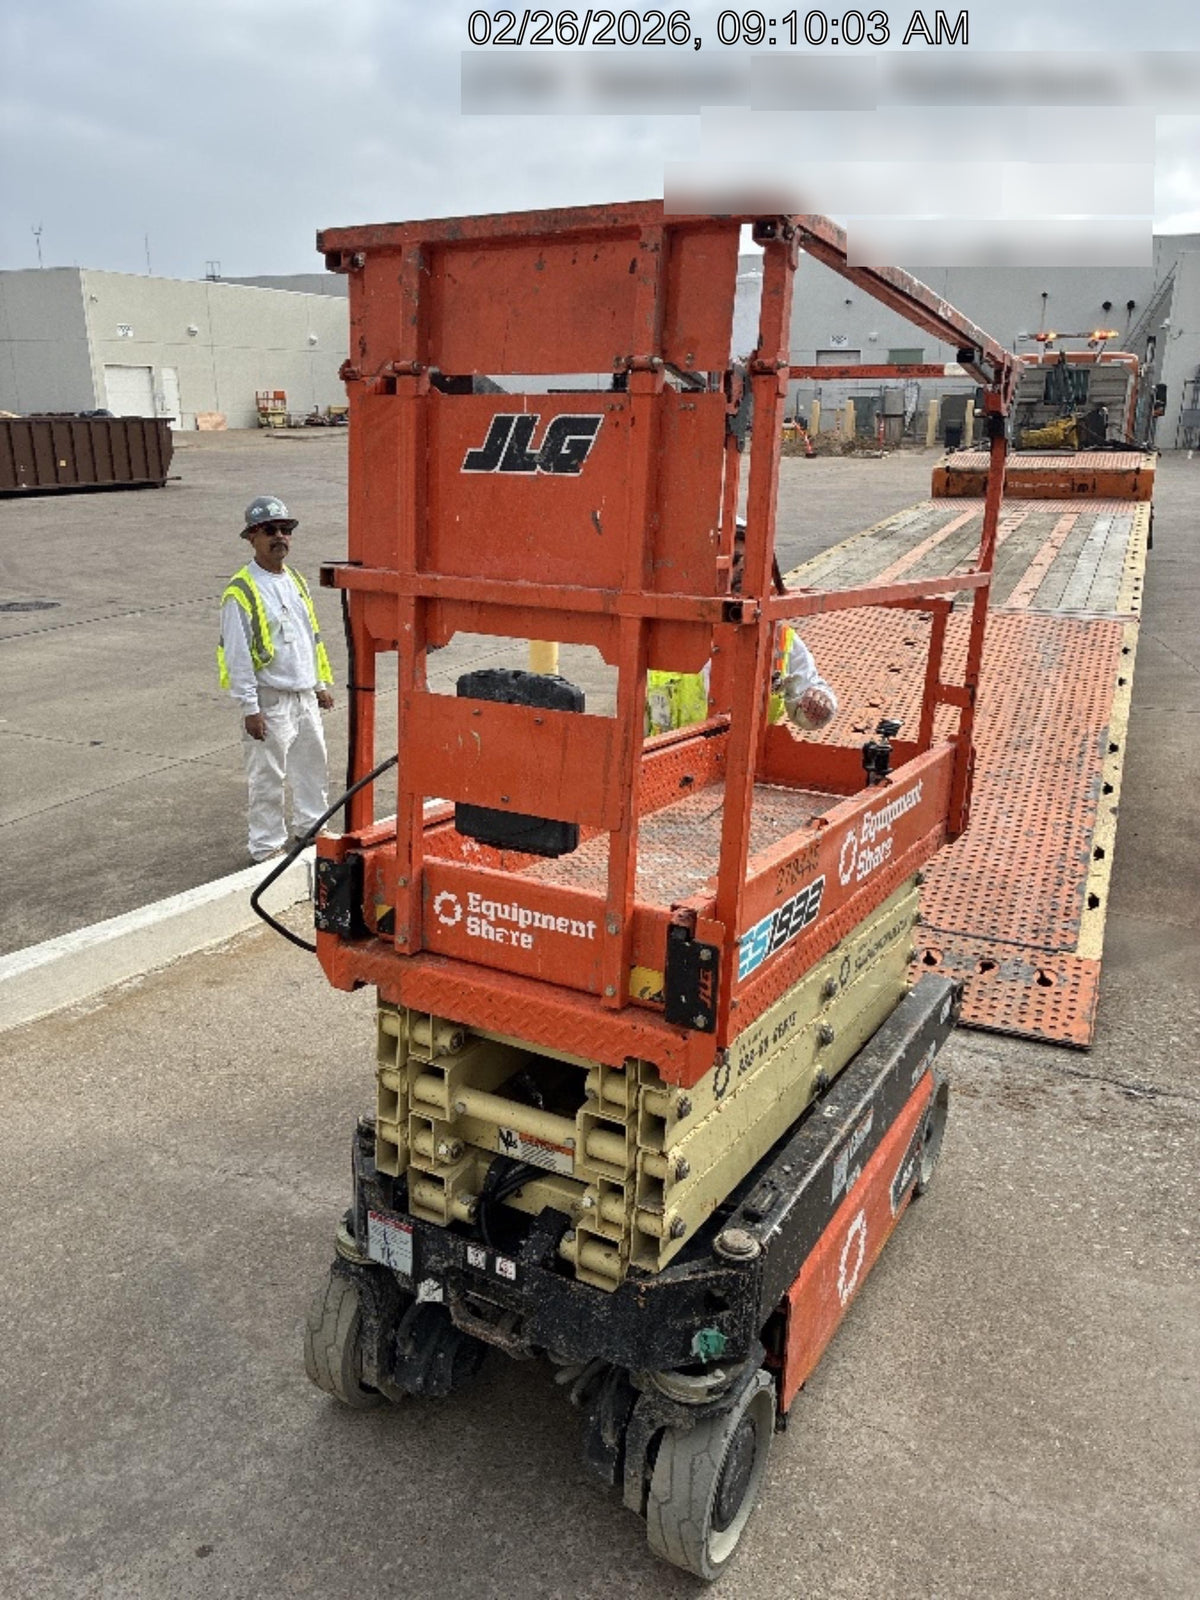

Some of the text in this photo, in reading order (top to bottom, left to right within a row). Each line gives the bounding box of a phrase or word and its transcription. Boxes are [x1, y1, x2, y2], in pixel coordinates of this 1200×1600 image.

[460, 413, 605, 477] JLG
[860, 778, 923, 844] Equipment
[857, 837, 893, 882] Share
[466, 915, 534, 949] Share
[467, 892, 597, 939] Equipment
[698, 967, 713, 1010] JLG
